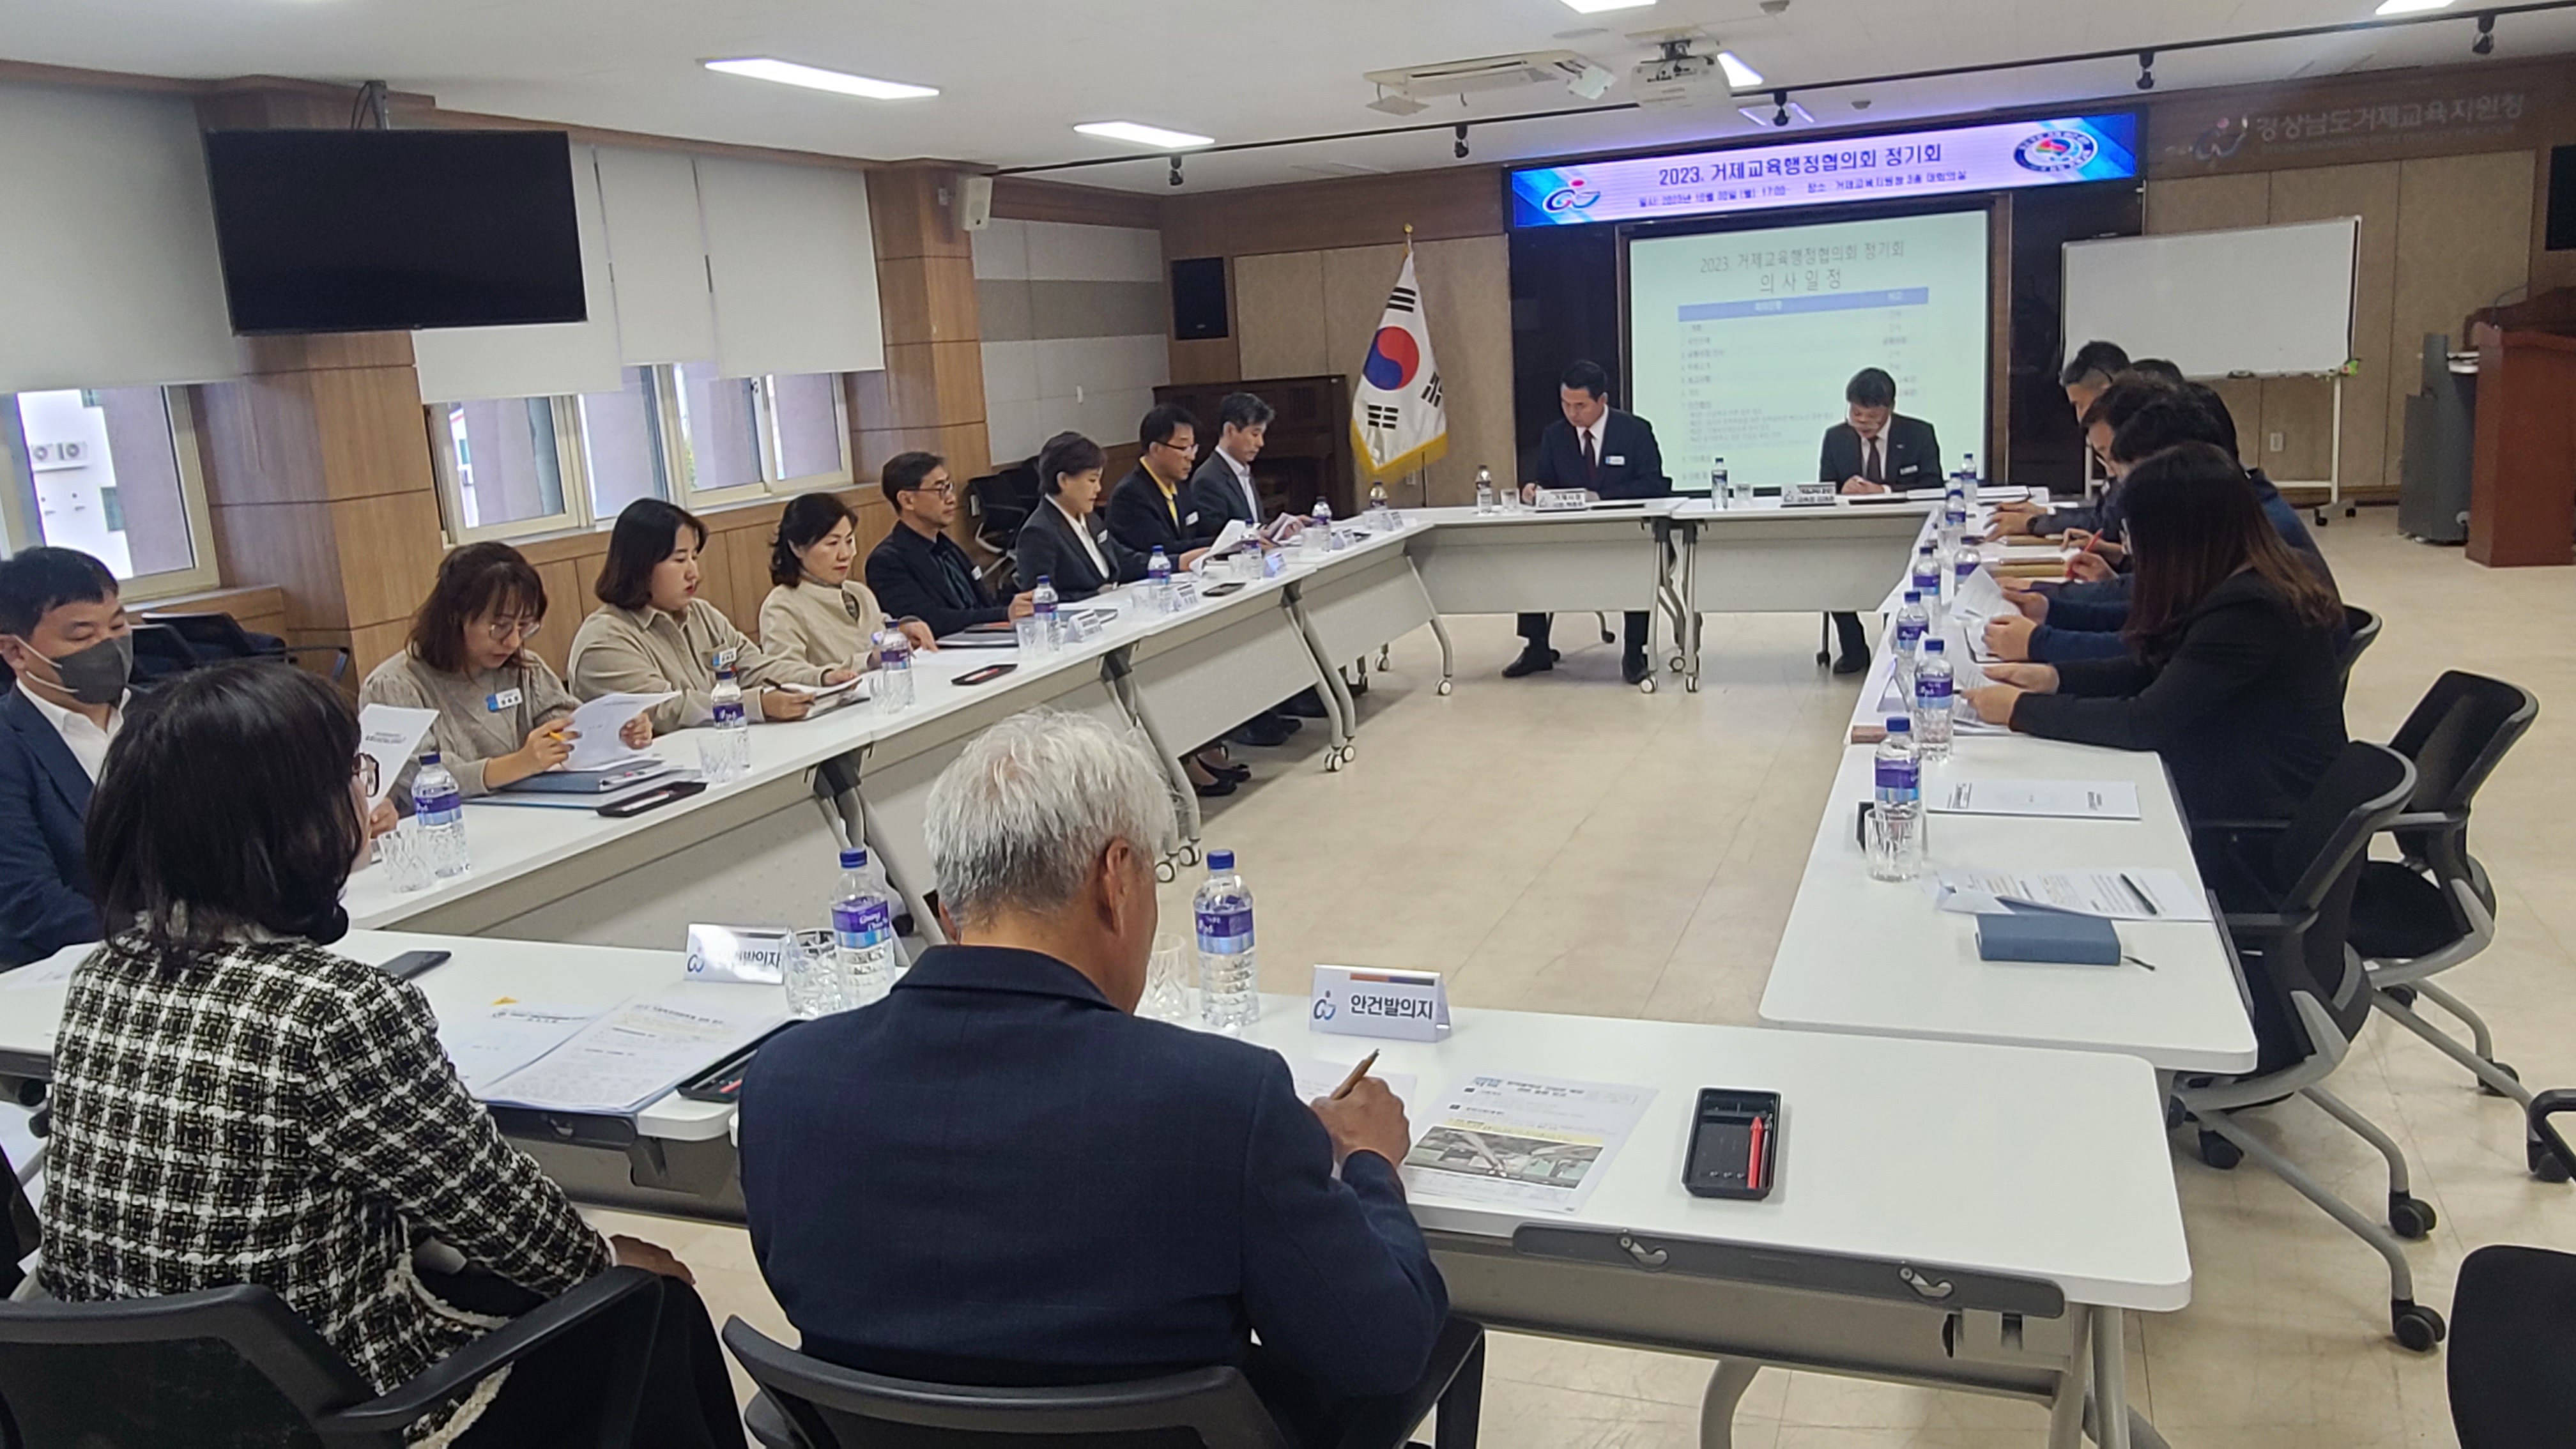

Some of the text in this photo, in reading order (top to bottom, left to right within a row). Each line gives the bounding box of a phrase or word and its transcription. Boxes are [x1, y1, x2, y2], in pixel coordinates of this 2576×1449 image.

[1659, 143, 1942, 185] 2023. 거제교육행정협의회 정기회
[1737, 245, 1858, 270] 거제교육행정협의회
[1864, 240, 1904, 261] 정기회
